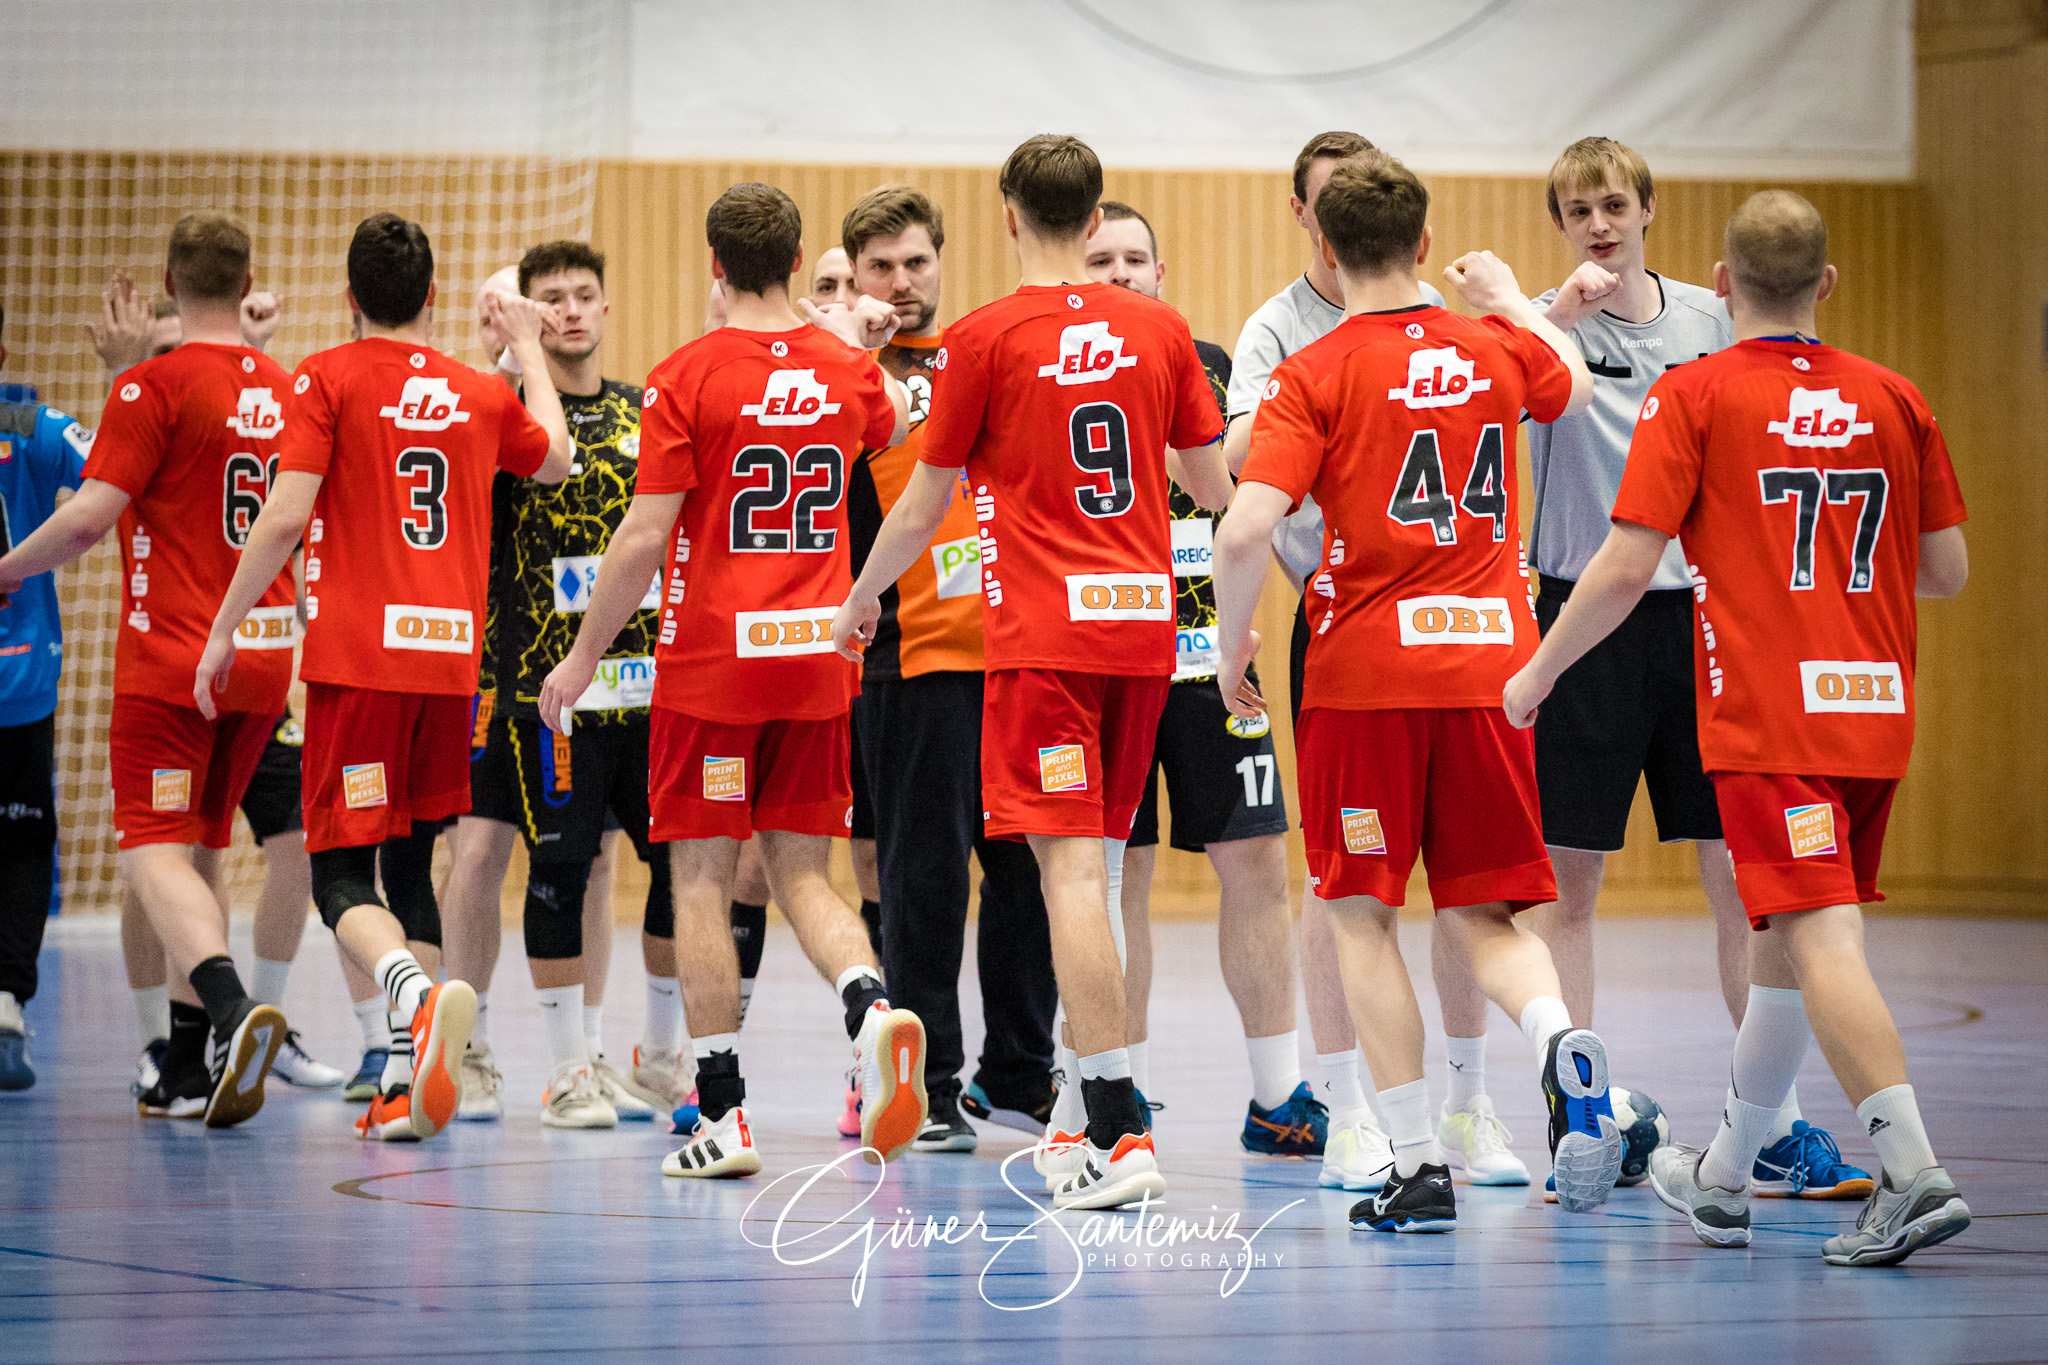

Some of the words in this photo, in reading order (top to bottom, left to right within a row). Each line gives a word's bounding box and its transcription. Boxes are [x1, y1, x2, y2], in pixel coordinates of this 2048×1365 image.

[1620, 337, 1663, 350] Kempa
[765, 387, 820, 416] ELO
[1068, 401, 1135, 518] 9
[1387, 423, 1507, 546] 44
[395, 447, 449, 550] 3
[730, 444, 844, 553] 22
[1757, 467, 1889, 592] 77
[1081, 585, 1165, 609] OBI
[238, 617, 293, 639] OBI
[396, 616, 469, 642] OBI
[1412, 606, 1506, 633] OBI
[1815, 673, 1896, 700] OBI
[708, 763, 739, 776] PRINT
[1046, 751, 1077, 767] PRINT
[1055, 762, 1072, 772] and
[708, 781, 739, 793] PIXEL
[1047, 770, 1080, 785] PIXEL
[1235, 754, 1275, 807] 17
[1346, 816, 1373, 829] PRINT
[1793, 810, 1827, 830] PRINT
[1350, 834, 1379, 848] PIXEL
[1797, 831, 1831, 850] PIXEL
